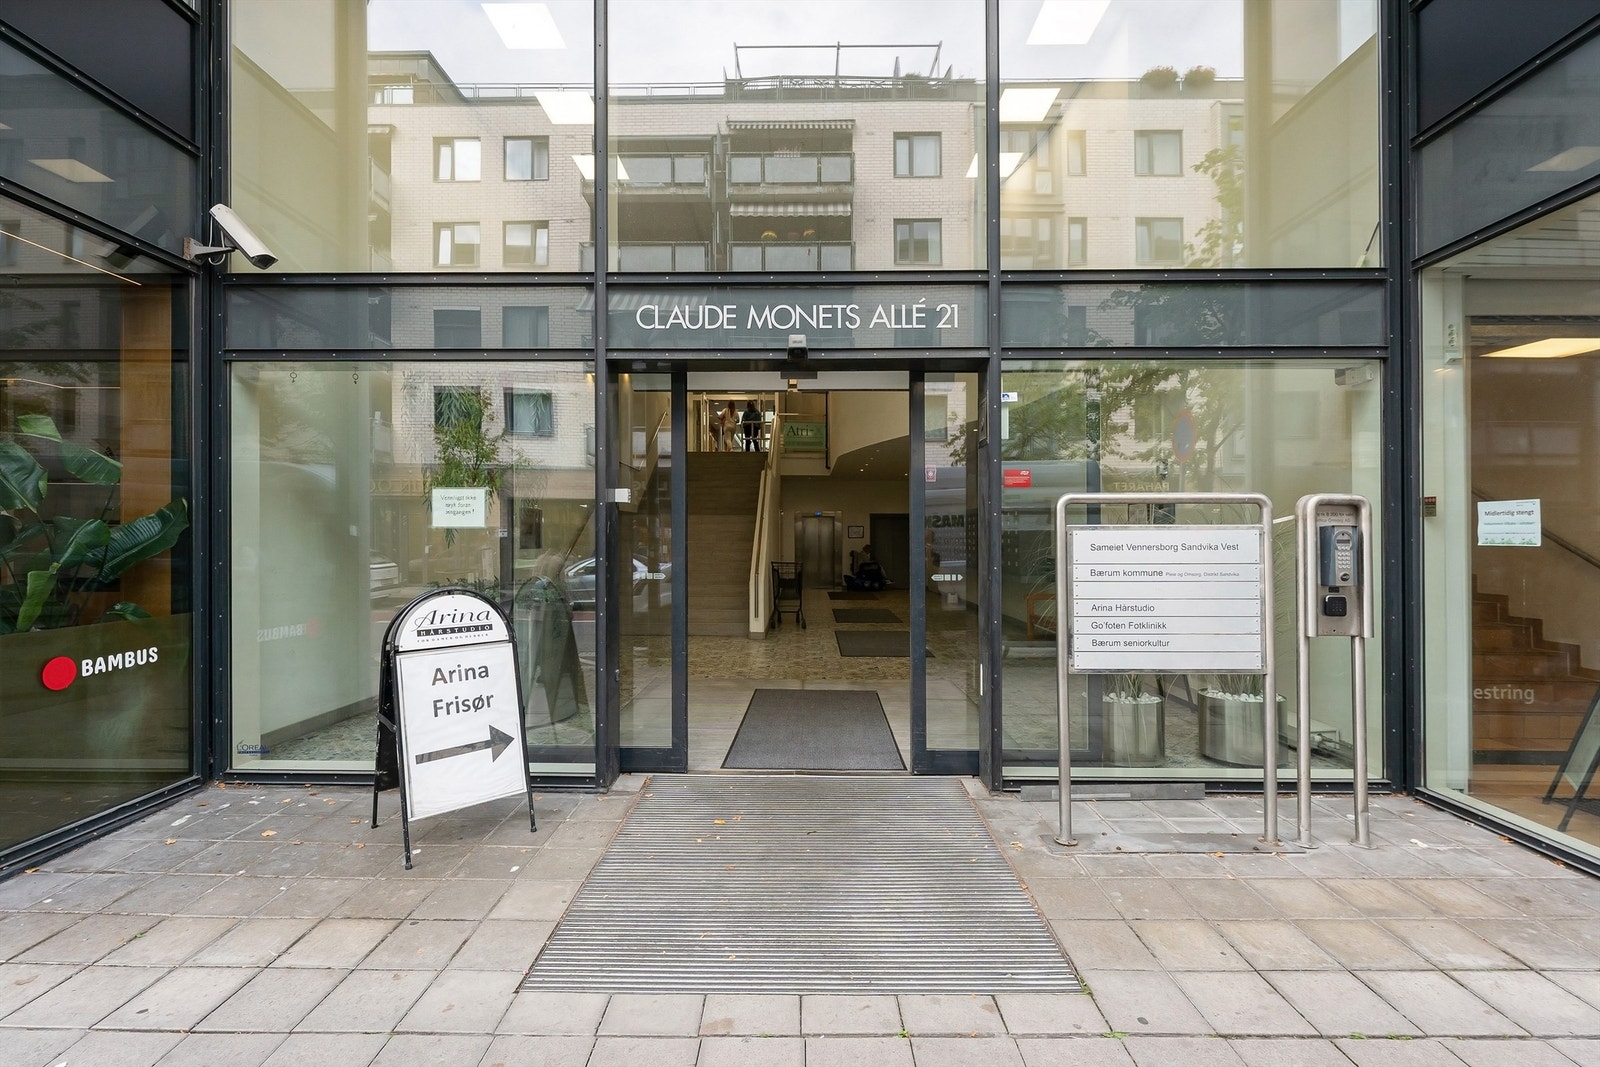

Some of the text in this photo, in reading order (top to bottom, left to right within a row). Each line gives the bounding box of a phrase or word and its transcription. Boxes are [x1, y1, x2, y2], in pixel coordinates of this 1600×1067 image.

[636, 297, 960, 330] CLAUDE MONETS ALLÉ 21
[1089, 543, 1240, 553] Sameiet Vennersborg Sandvika Vest
[1090, 568, 1121, 577] Bærum
[1122, 568, 1164, 577] kommune
[1091, 603, 1155, 612] Arina Hårstudio
[411, 608, 492, 631] Arina
[1128, 621, 1168, 630] Fotklinikk
[1091, 639, 1170, 647] Bærum seniorkultur
[81, 646, 159, 677] BAMBUS
[431, 663, 490, 687] Arina
[432, 693, 495, 718] Frisør
